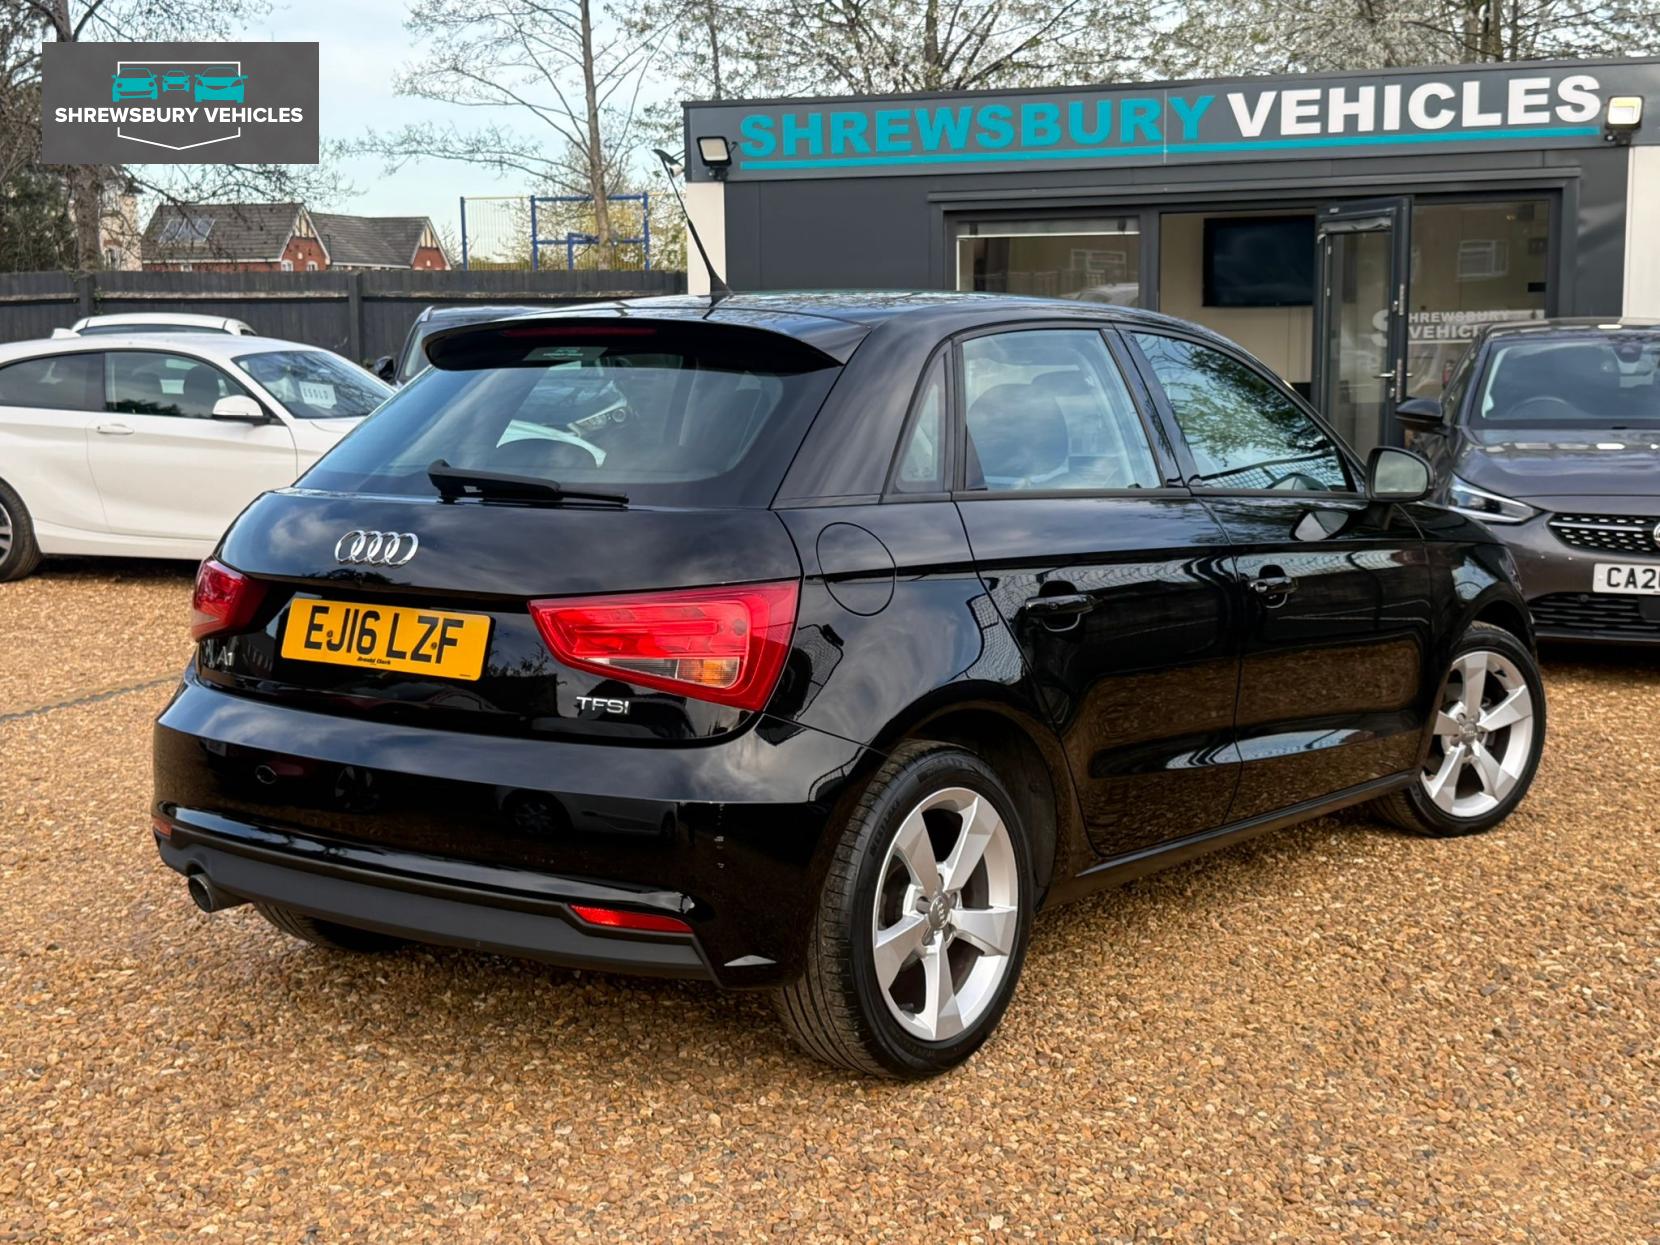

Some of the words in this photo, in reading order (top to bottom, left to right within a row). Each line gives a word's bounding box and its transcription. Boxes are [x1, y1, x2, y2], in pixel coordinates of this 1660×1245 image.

[740, 95, 1216, 157] SHREWSBURY
[1227, 75, 1601, 137] VEHICLES
[1607, 567, 1660, 589] CA2
[304, 605, 380, 655] EJ16
[386, 612, 464, 664] LZF
[216, 645, 233, 666] A1
[576, 696, 630, 715] TFSI
